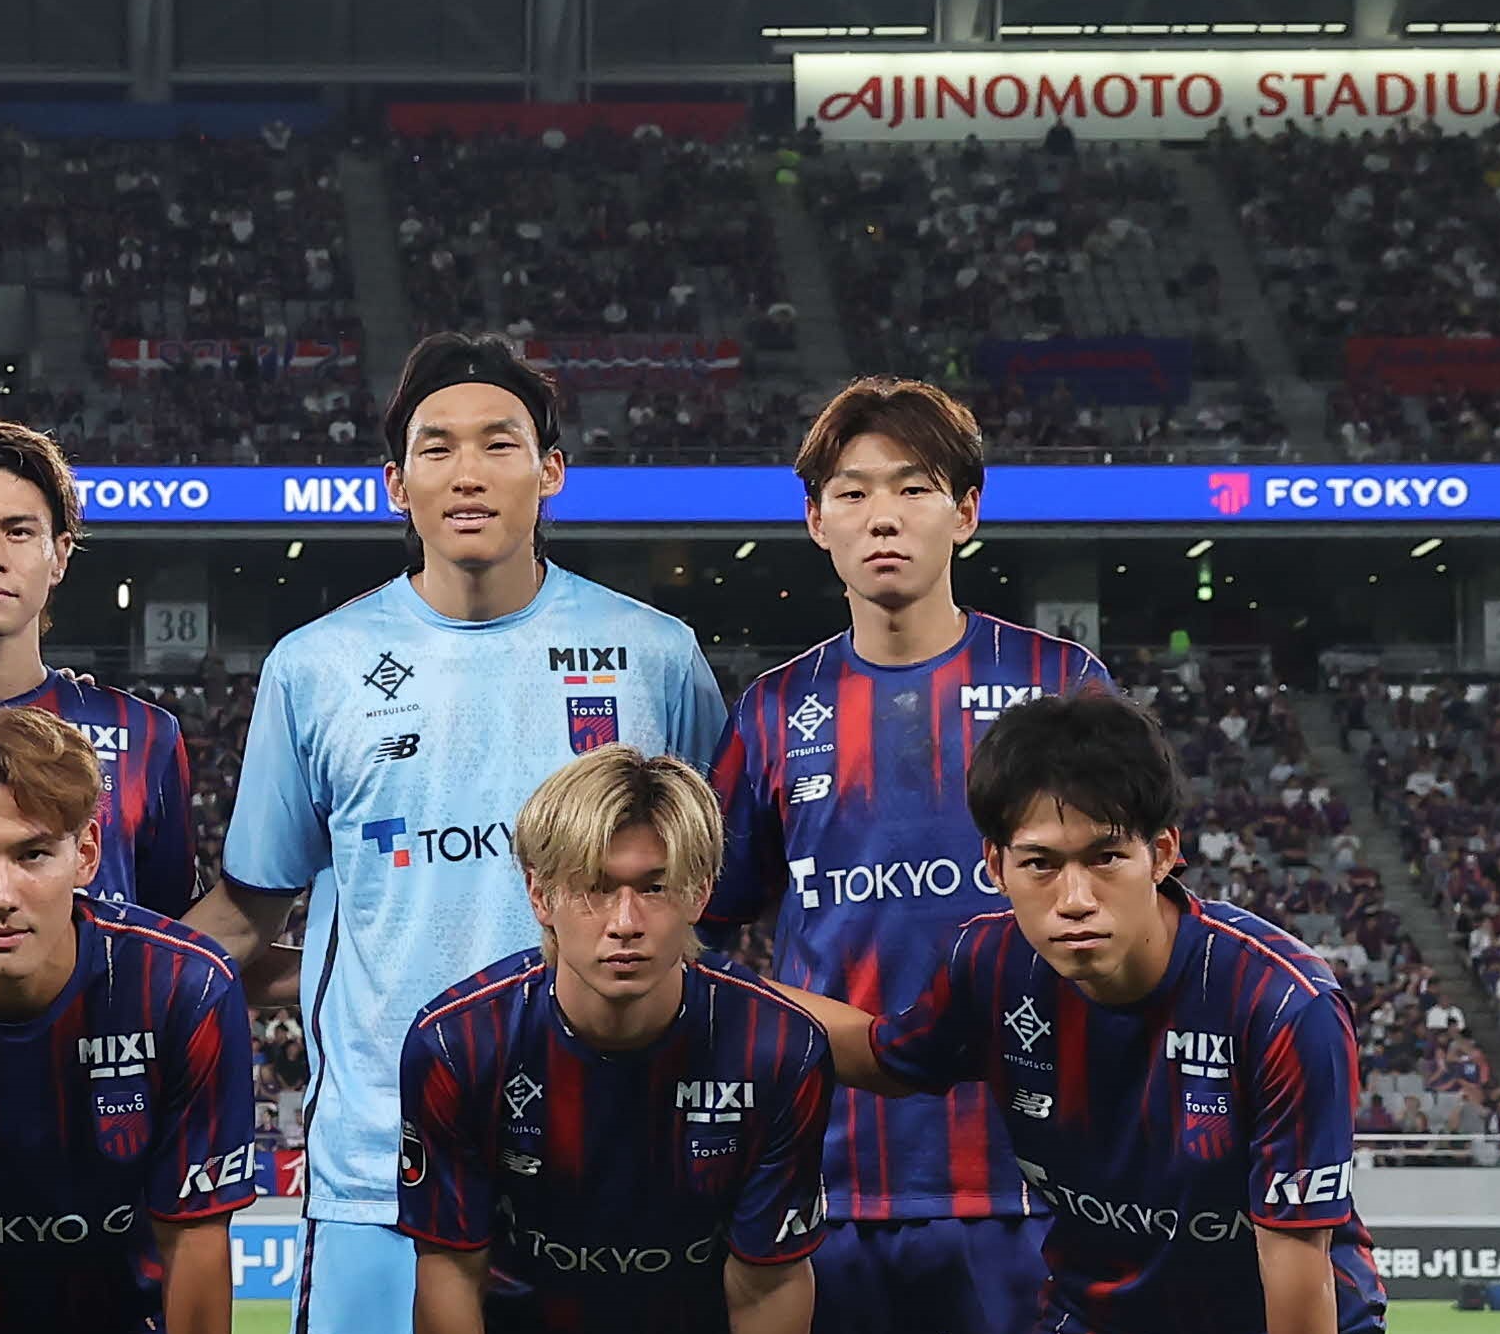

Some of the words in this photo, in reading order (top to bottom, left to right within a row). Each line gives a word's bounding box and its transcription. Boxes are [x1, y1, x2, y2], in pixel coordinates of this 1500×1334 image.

[817, 74, 1222, 128] AJINOMOTO
[284, 478, 376, 513] MIXI
[1265, 478, 1318, 507] FC
[1326, 478, 1469, 508] TOKYO
[156, 609, 197, 643] 38
[549, 647, 627, 672] MIXI
[961, 684, 1043, 710] MIXI
[418, 823, 517, 863] TOKY
[826, 858, 960, 905] TOKYO
[78, 1031, 156, 1065] MIXI
[1165, 1029, 1234, 1065] MIXI
[676, 1081, 755, 1109] MIXI
[528, 1229, 671, 1274] TOKYO
[1423, 1250, 1457, 1277] J1
